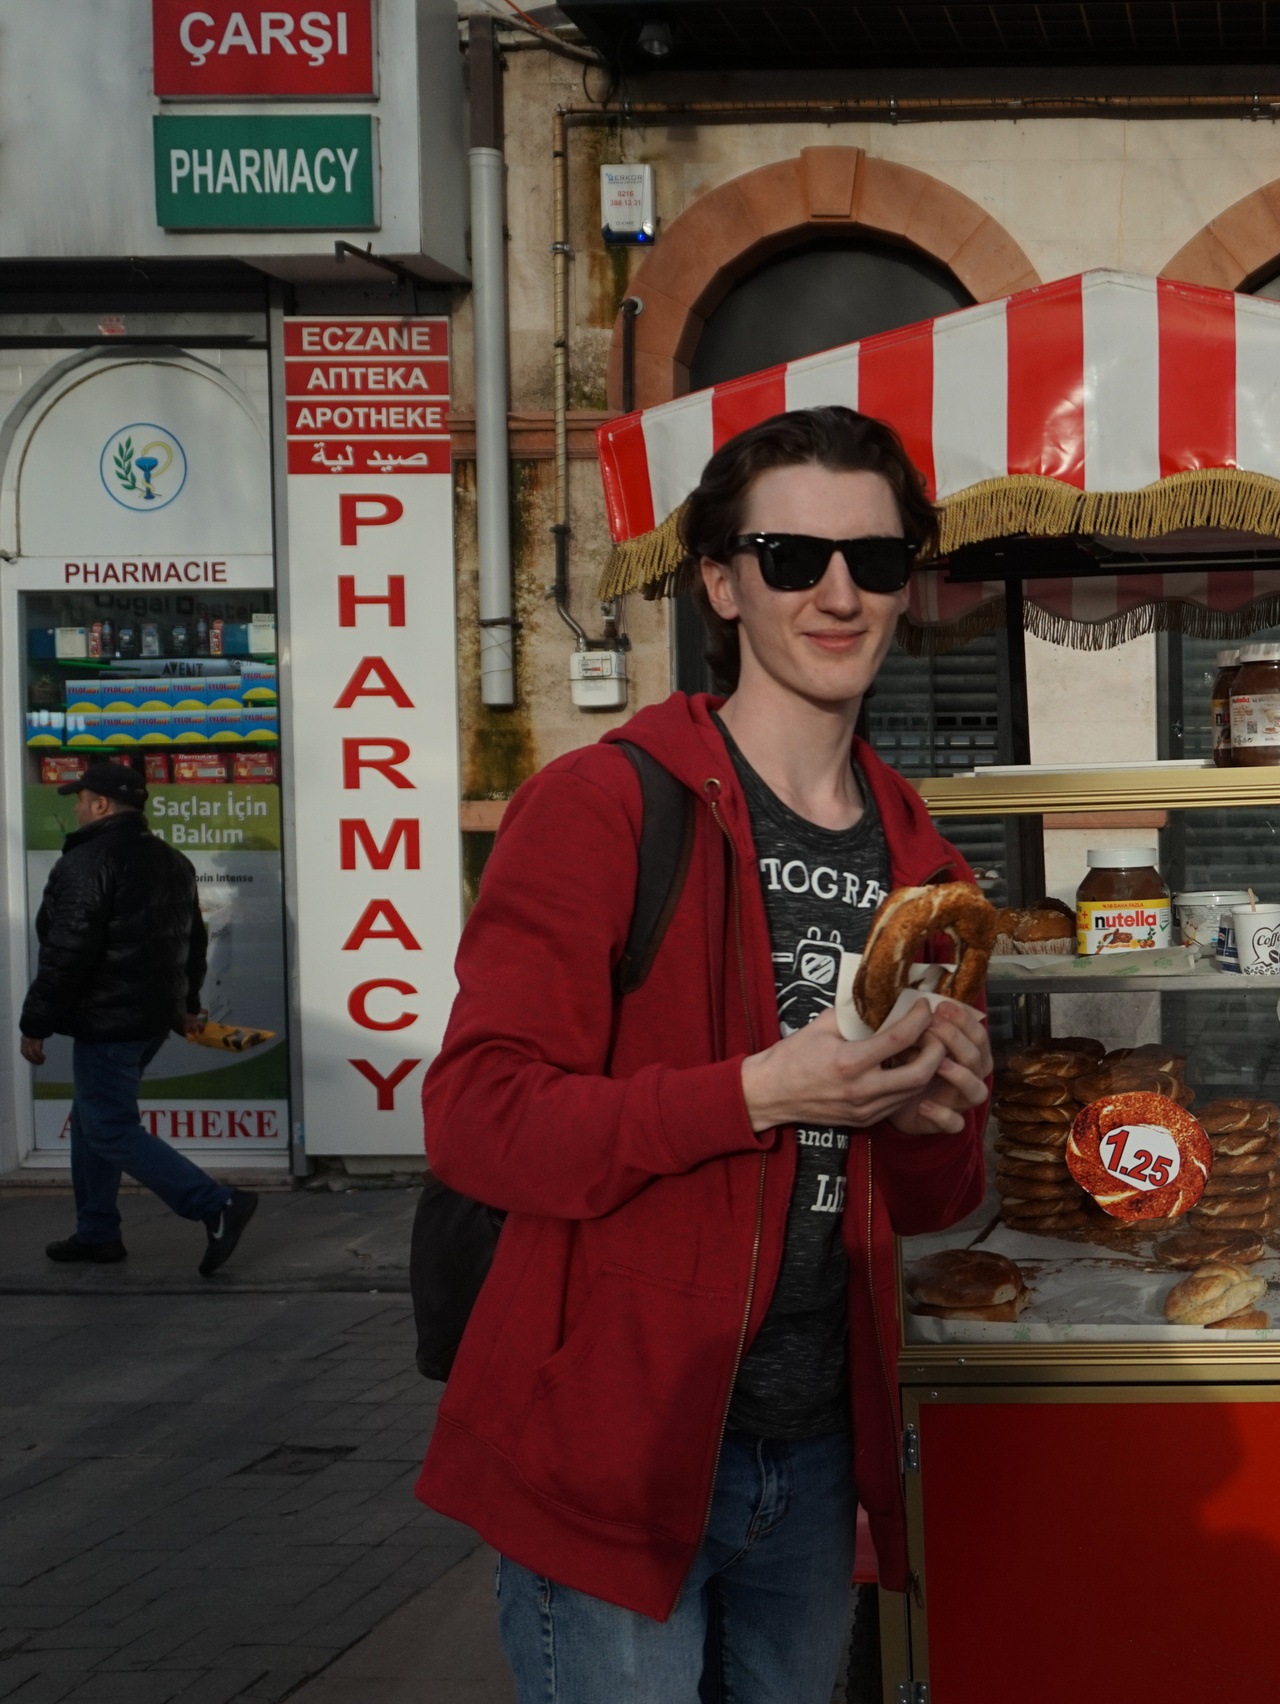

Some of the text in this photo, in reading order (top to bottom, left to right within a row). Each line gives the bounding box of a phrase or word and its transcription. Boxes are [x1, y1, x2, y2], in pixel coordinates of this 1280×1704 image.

[179, 12, 348, 67] ÇARŞI
[171, 148, 359, 194] PHARMACY
[301, 326, 431, 351] ECZANE
[306, 367, 429, 390] АПТЕКА
[295, 406, 441, 430] APOTHEKE
[64, 561, 228, 584] PHARMACIE
[152, 790, 268, 821] Saçlar İçin
[333, 494, 421, 1110] PHARMACY
[171, 823, 244, 844] Bakım
[216, 872, 254, 883] Intense
[1095, 910, 1157, 928] nutella
[796, 1128, 833, 1148] and
[1106, 1129, 1174, 1187] 1.25
